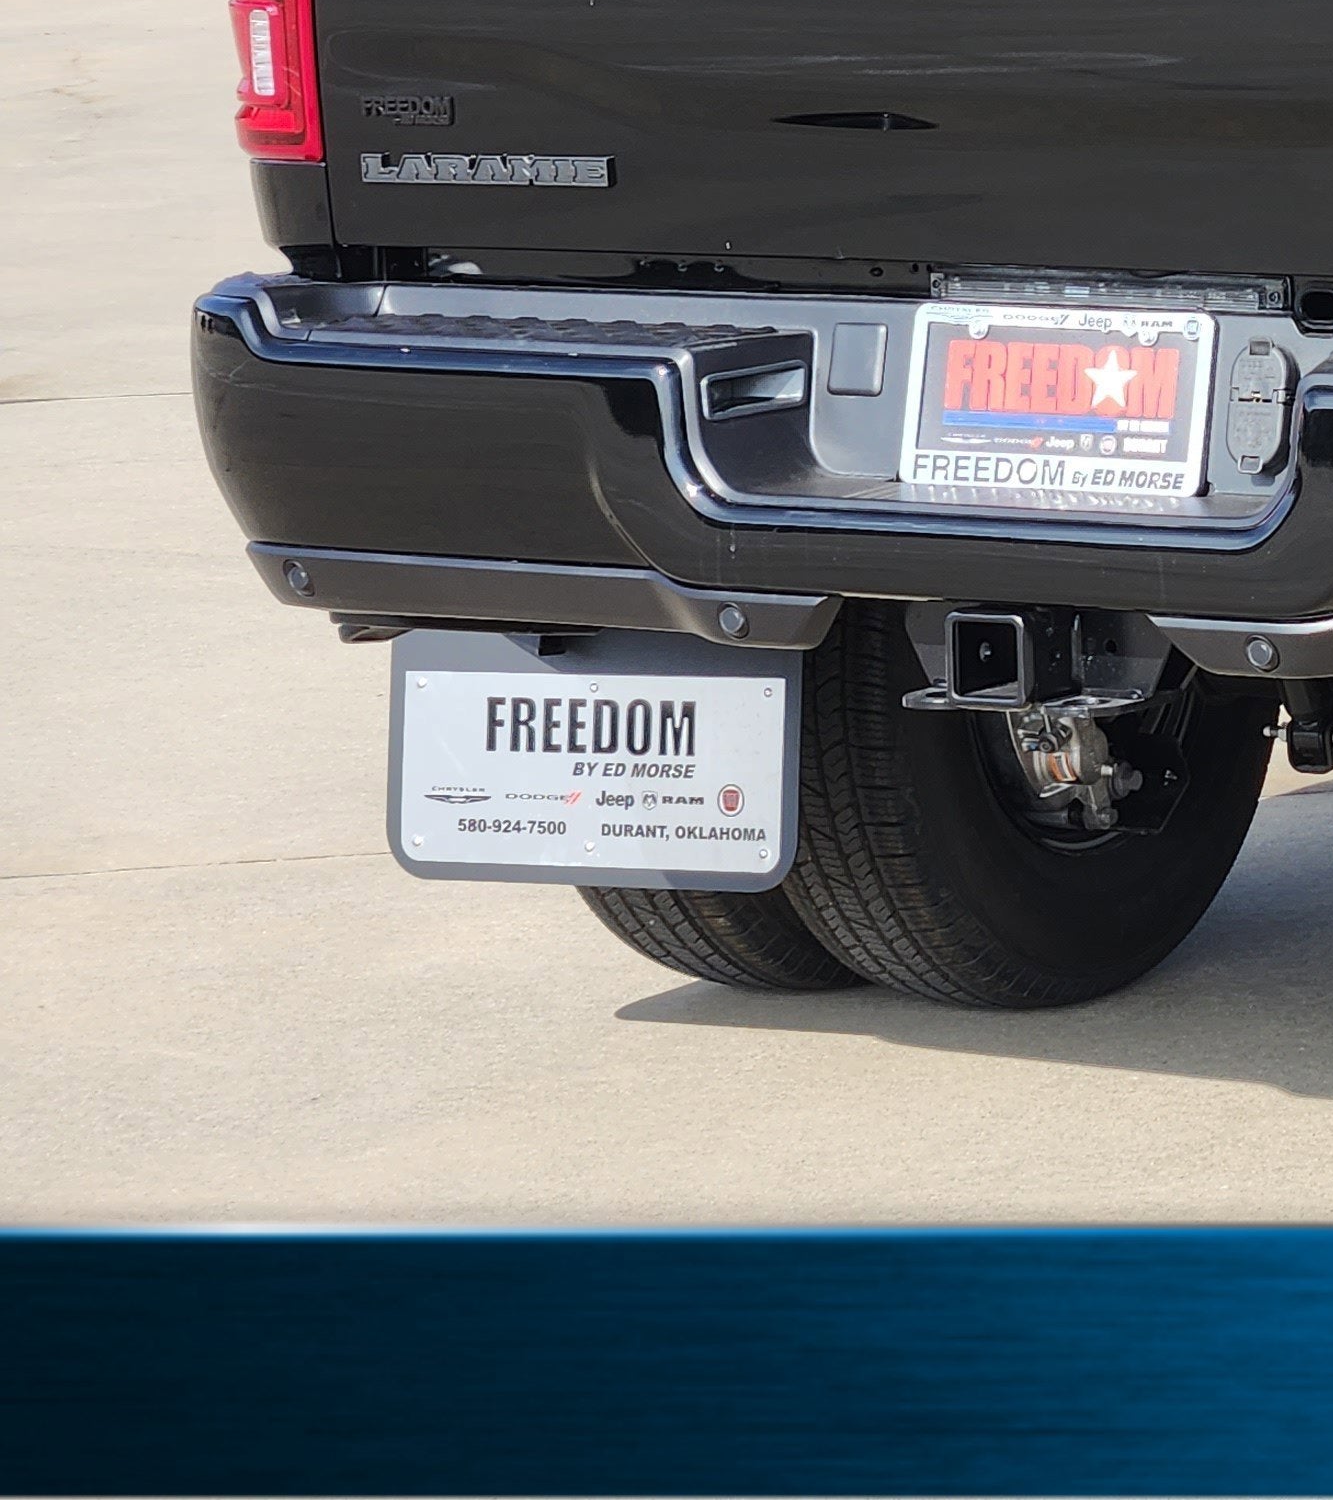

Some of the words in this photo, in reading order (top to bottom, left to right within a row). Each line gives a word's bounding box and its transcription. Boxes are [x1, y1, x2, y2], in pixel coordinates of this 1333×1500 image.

[362, 96, 450, 116] FREEDOM
[360, 153, 614, 187] LARAMIE
[1078, 313, 1112, 330] Jeep
[1046, 435, 1075, 451] Jeep
[912, 453, 1066, 486] FREEDOM
[1090, 468, 1116, 487] ED
[1118, 470, 1185, 491] MORSE
[485, 696, 698, 757] FREEDOM
[572, 762, 598, 778] BY
[601, 763, 627, 778] ED
[630, 763, 697, 779] MORSE
[595, 791, 635, 809] Jeep
[662, 796, 705, 806] RAM
[457, 818, 567, 836] 580-924-7500
[600, 823, 670, 842] DURANT,
[674, 826, 767, 842] OKLAHOMA
